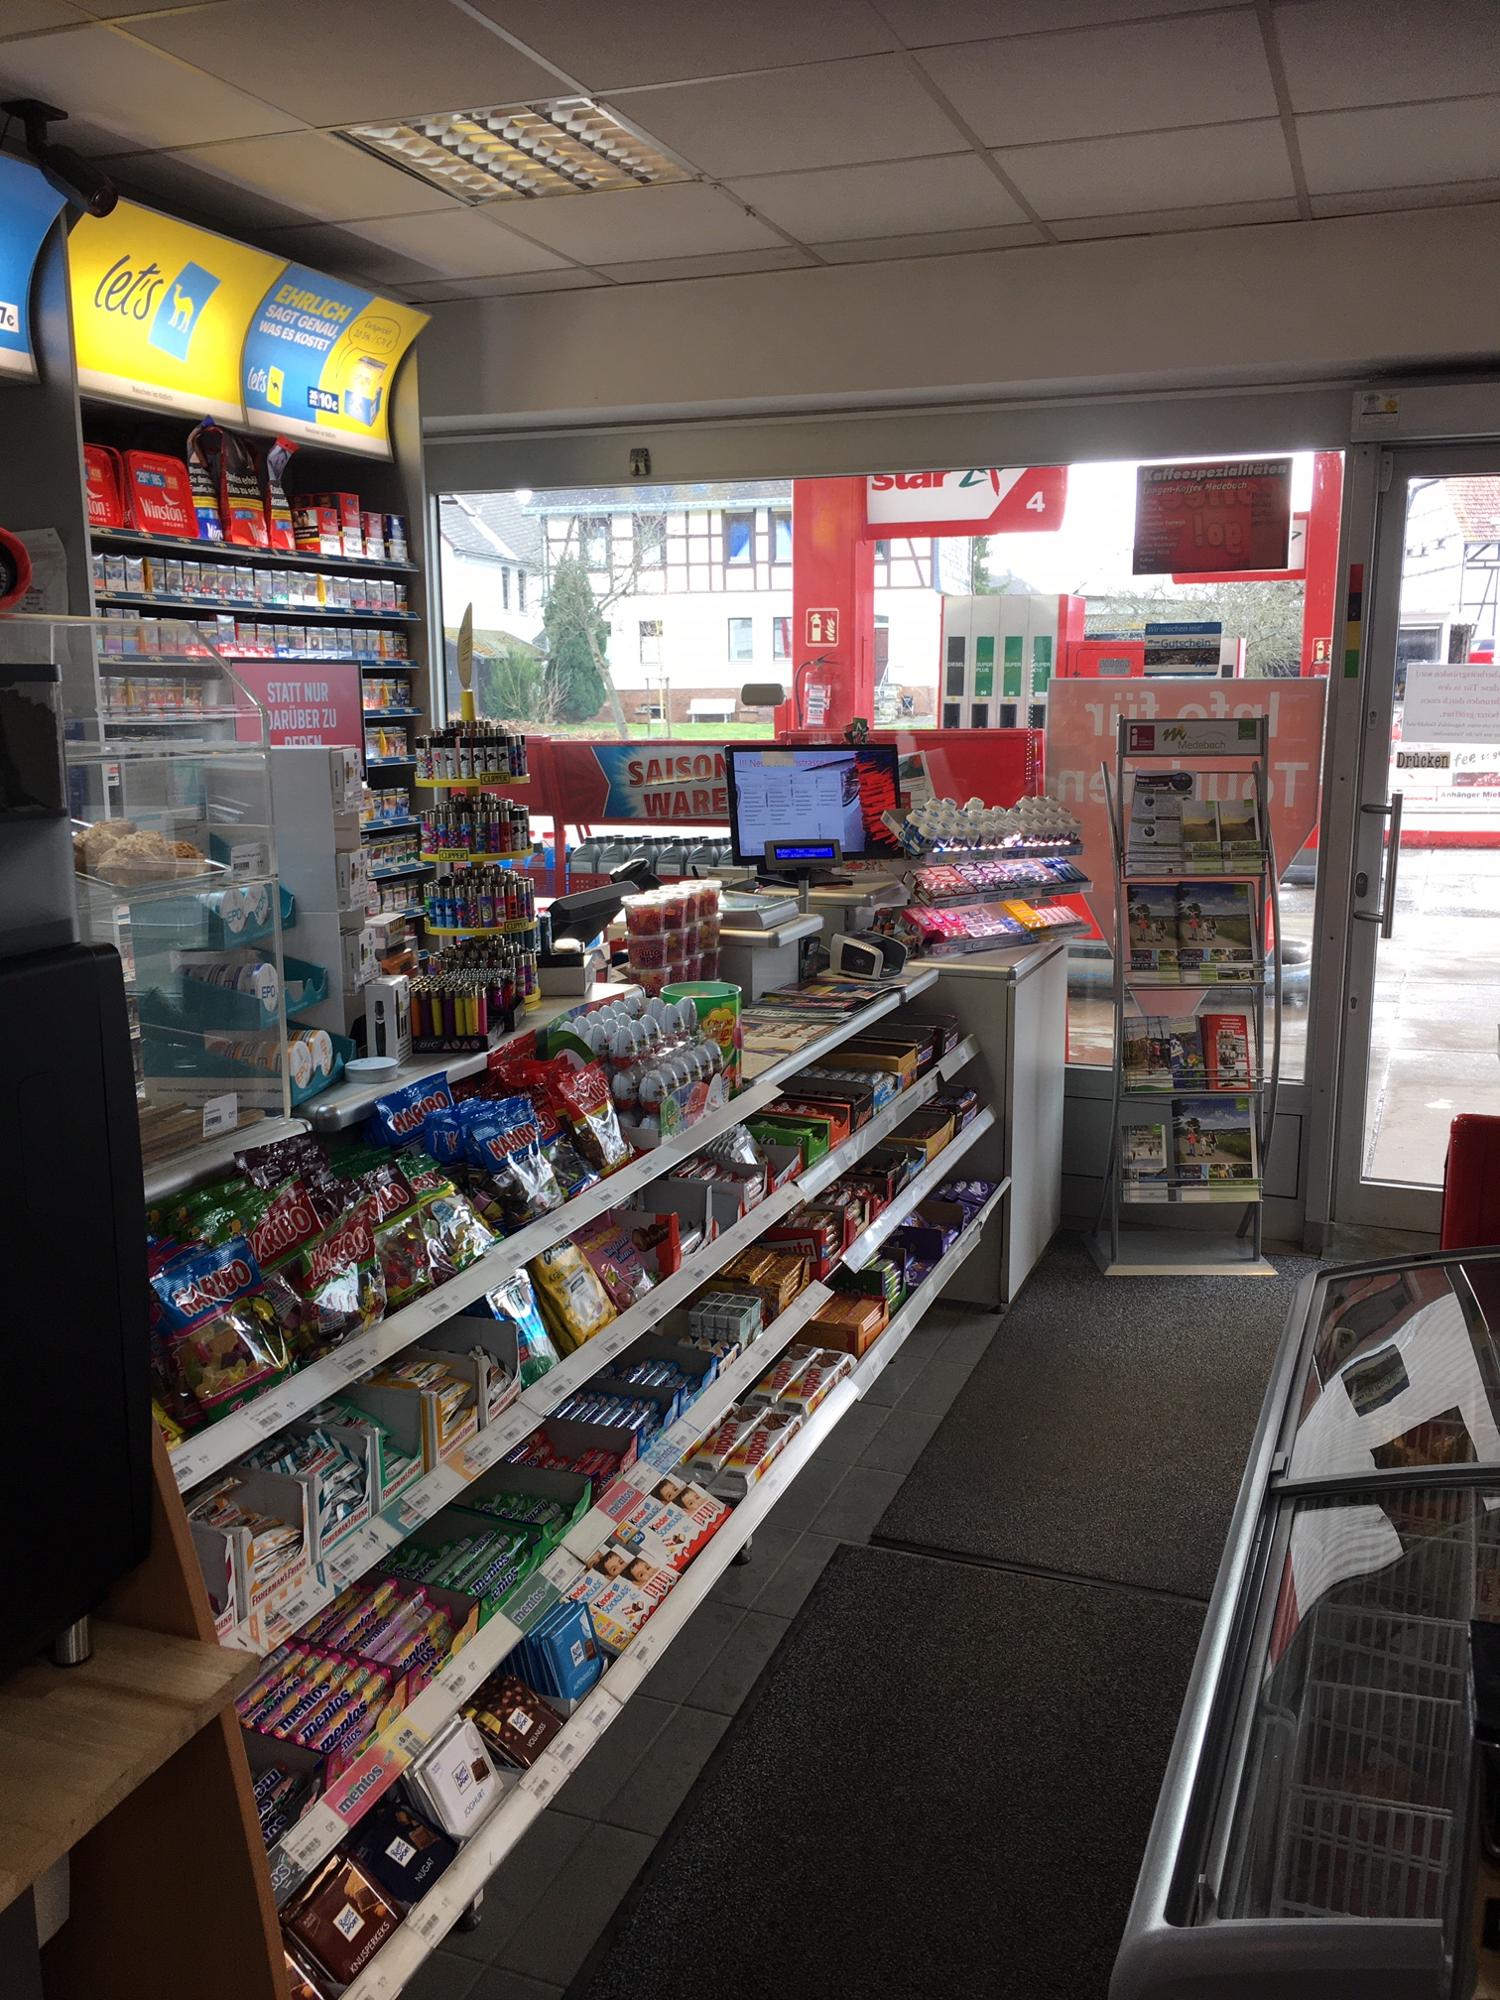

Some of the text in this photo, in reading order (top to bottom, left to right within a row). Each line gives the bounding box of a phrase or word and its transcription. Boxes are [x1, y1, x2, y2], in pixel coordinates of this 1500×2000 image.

[273, 284, 353, 323] EHRLICH
[259, 321, 281, 338] WAS
[281, 328, 294, 342] ES
[294, 332, 331, 352] KOSTET
[265, 304, 300, 323] SAGT
[297, 315, 339, 340] GENAU,
[871, 472, 951, 491] star
[1142, 463, 1288, 481] Kaffeespezialitäten
[139, 495, 184, 524] Winston
[1026, 491, 1046, 513] 4
[267, 681, 328, 705] STATT NUR
[267, 708, 336, 732] DARÜBER ZU
[1178, 740, 1226, 751] Medebach
[1396, 752, 1449, 768] Drücken
[628, 753, 728, 788] SAISON
[643, 786, 729, 818] WARE
[487, 1120, 538, 1160] HARIBO
[306, 1226, 372, 1277] HARIBO
[173, 1258, 254, 1317] HARIBO
[744, 1430, 769, 1465] nippon
[607, 1487, 634, 1516] mentos
[657, 1510, 682, 1538] SCHOKOLADE
[250, 1558, 308, 1604] FISHERMAN'S FRIEND
[470, 1553, 509, 1591] mentos
[513, 1587, 546, 1623] mentos
[603, 1583, 631, 1614] SCHOKOLADE
[214, 1613, 231, 1630] RIEND
[360, 1619, 389, 1649] mentos
[279, 1681, 329, 1729] mentos
[299, 1689, 352, 1739] mentos
[317, 1700, 371, 1751] mentos
[336, 1764, 384, 1813] mentos
[412, 1857, 436, 1881] NUGAT
[345, 1922, 394, 1971] KNUSPERKEKS
